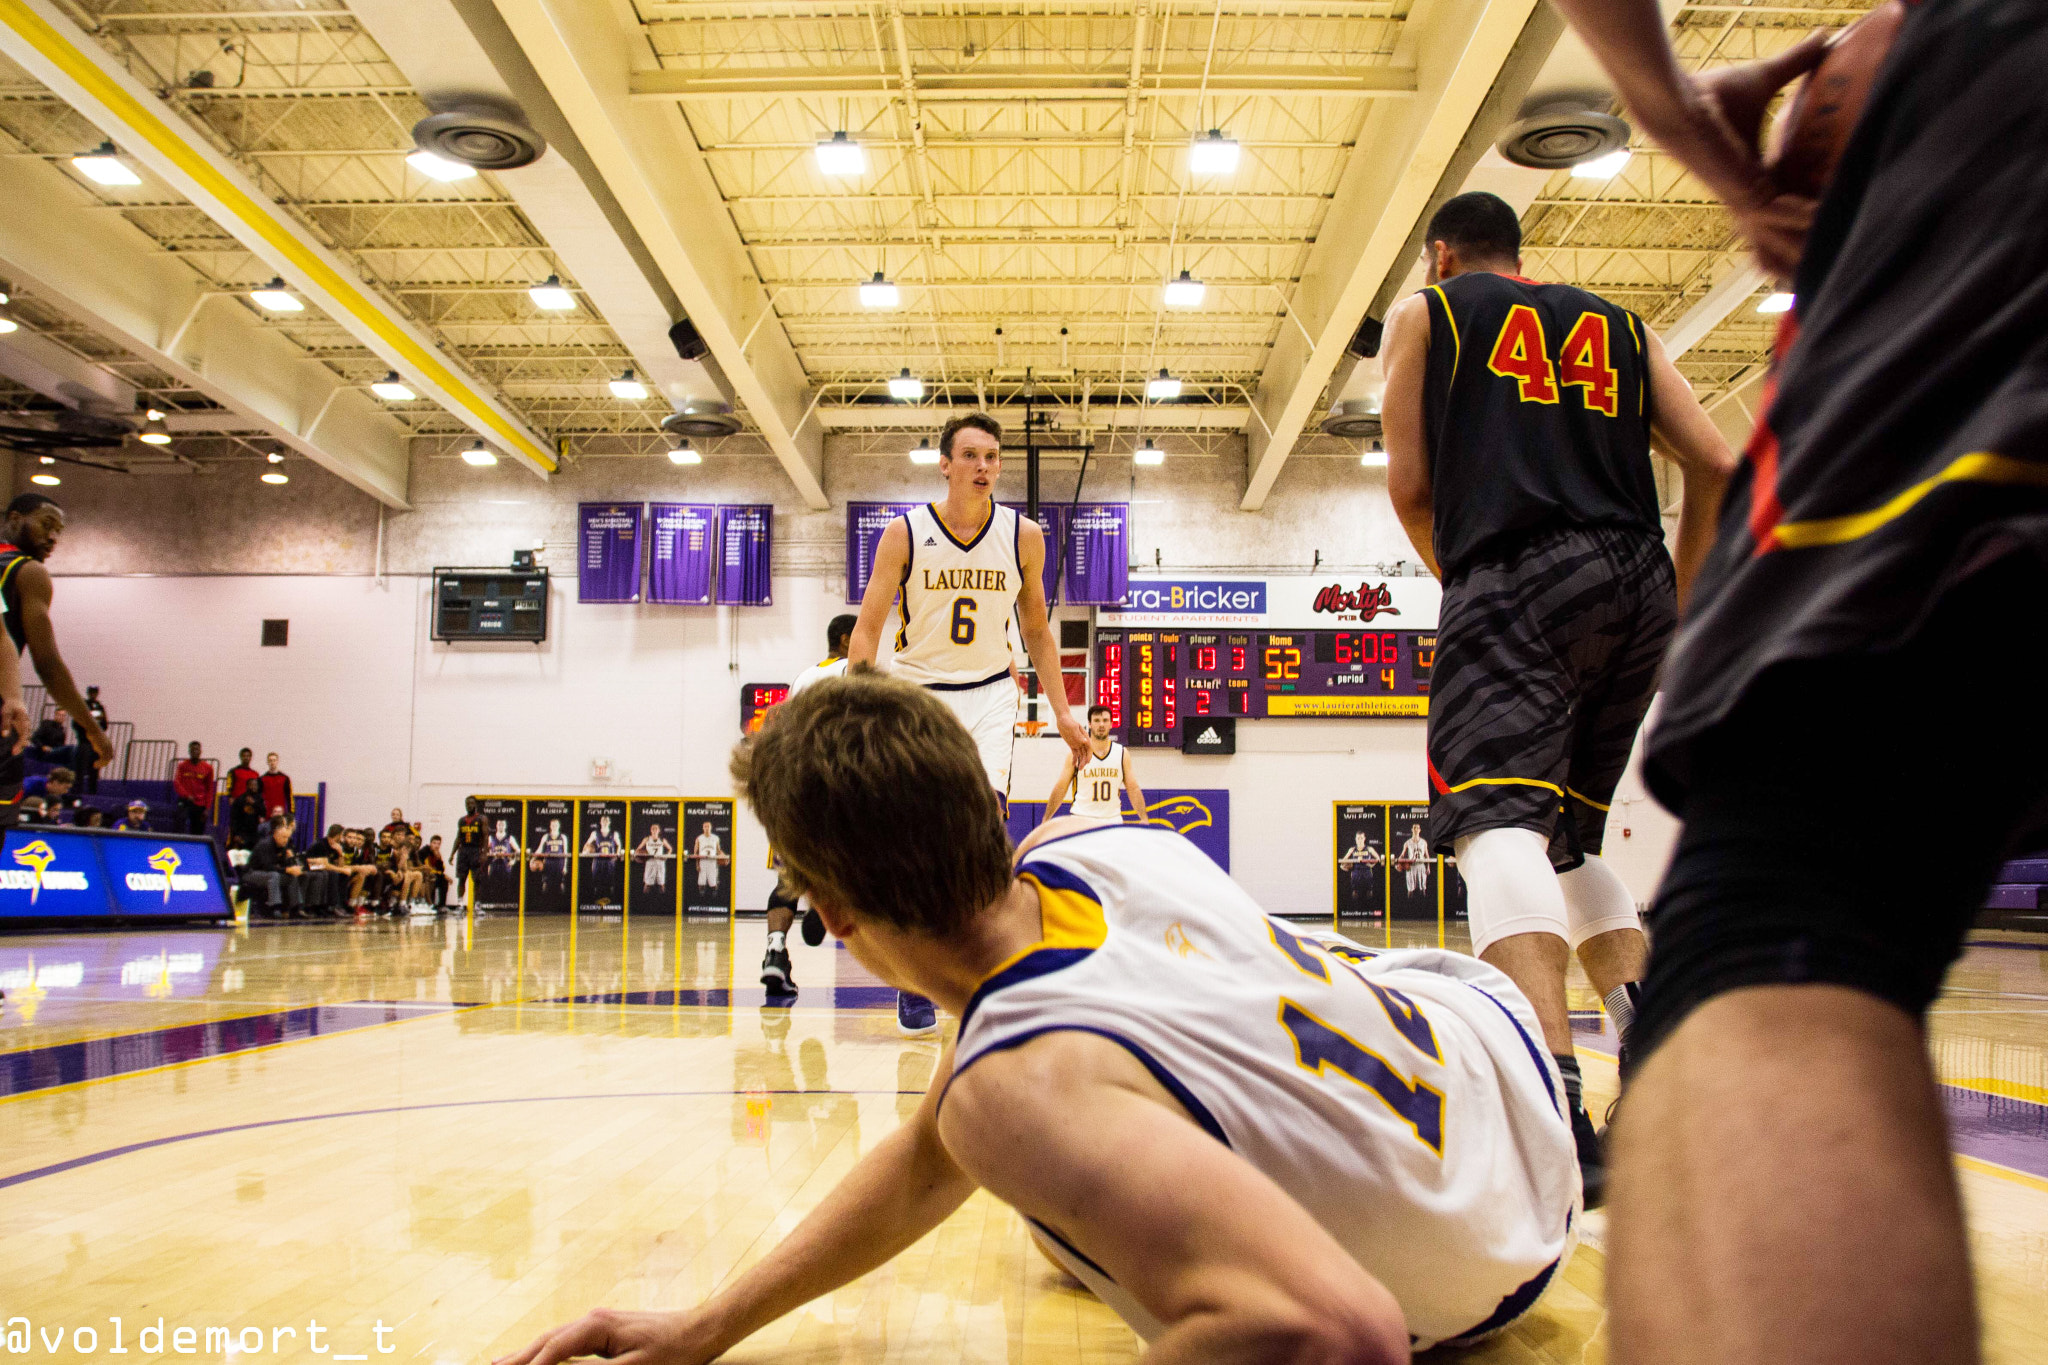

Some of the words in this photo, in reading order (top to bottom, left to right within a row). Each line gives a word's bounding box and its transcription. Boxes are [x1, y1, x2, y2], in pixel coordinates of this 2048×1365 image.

[1487, 303, 1618, 418] 44
[923, 569, 1007, 592] LAURIER
[1121, 585, 1260, 609] zra-Bricker
[1313, 582, 1401, 622] Morty's
[950, 595, 978, 647] 6
[1172, 615, 1259, 623] APARTMENTS
[1129, 633, 1153, 642] points
[1160, 634, 1180, 643] fouls
[1190, 635, 1217, 645] player
[1228, 636, 1248, 645] fouls
[1269, 635, 1293, 646] Home
[1418, 636, 1437, 647] Gues
[1140, 644, 1153, 662] 5
[1335, 633, 1398, 664] 6:06
[1197, 647, 1217, 671] 13
[1232, 647, 1245, 671] 3
[1265, 648, 1301, 680] 52
[1418, 651, 1435, 667] 4
[1140, 662, 1153, 678] 4
[1140, 678, 1153, 695] 8
[1164, 678, 1176, 695] 4
[1228, 679, 1248, 688] team
[1337, 674, 1364, 685] period
[1381, 668, 1395, 691] 4
[1140, 695, 1153, 711] 4
[1164, 695, 1176, 711] 4
[1196, 690, 1211, 715] 2
[1242, 692, 1248, 713] 1
[1137, 710, 1153, 728] 13
[1164, 711, 1176, 728] 3
[1197, 737, 1221, 745] adidas
[1083, 768, 1119, 778] LAURIER
[1092, 781, 1111, 802] 10
